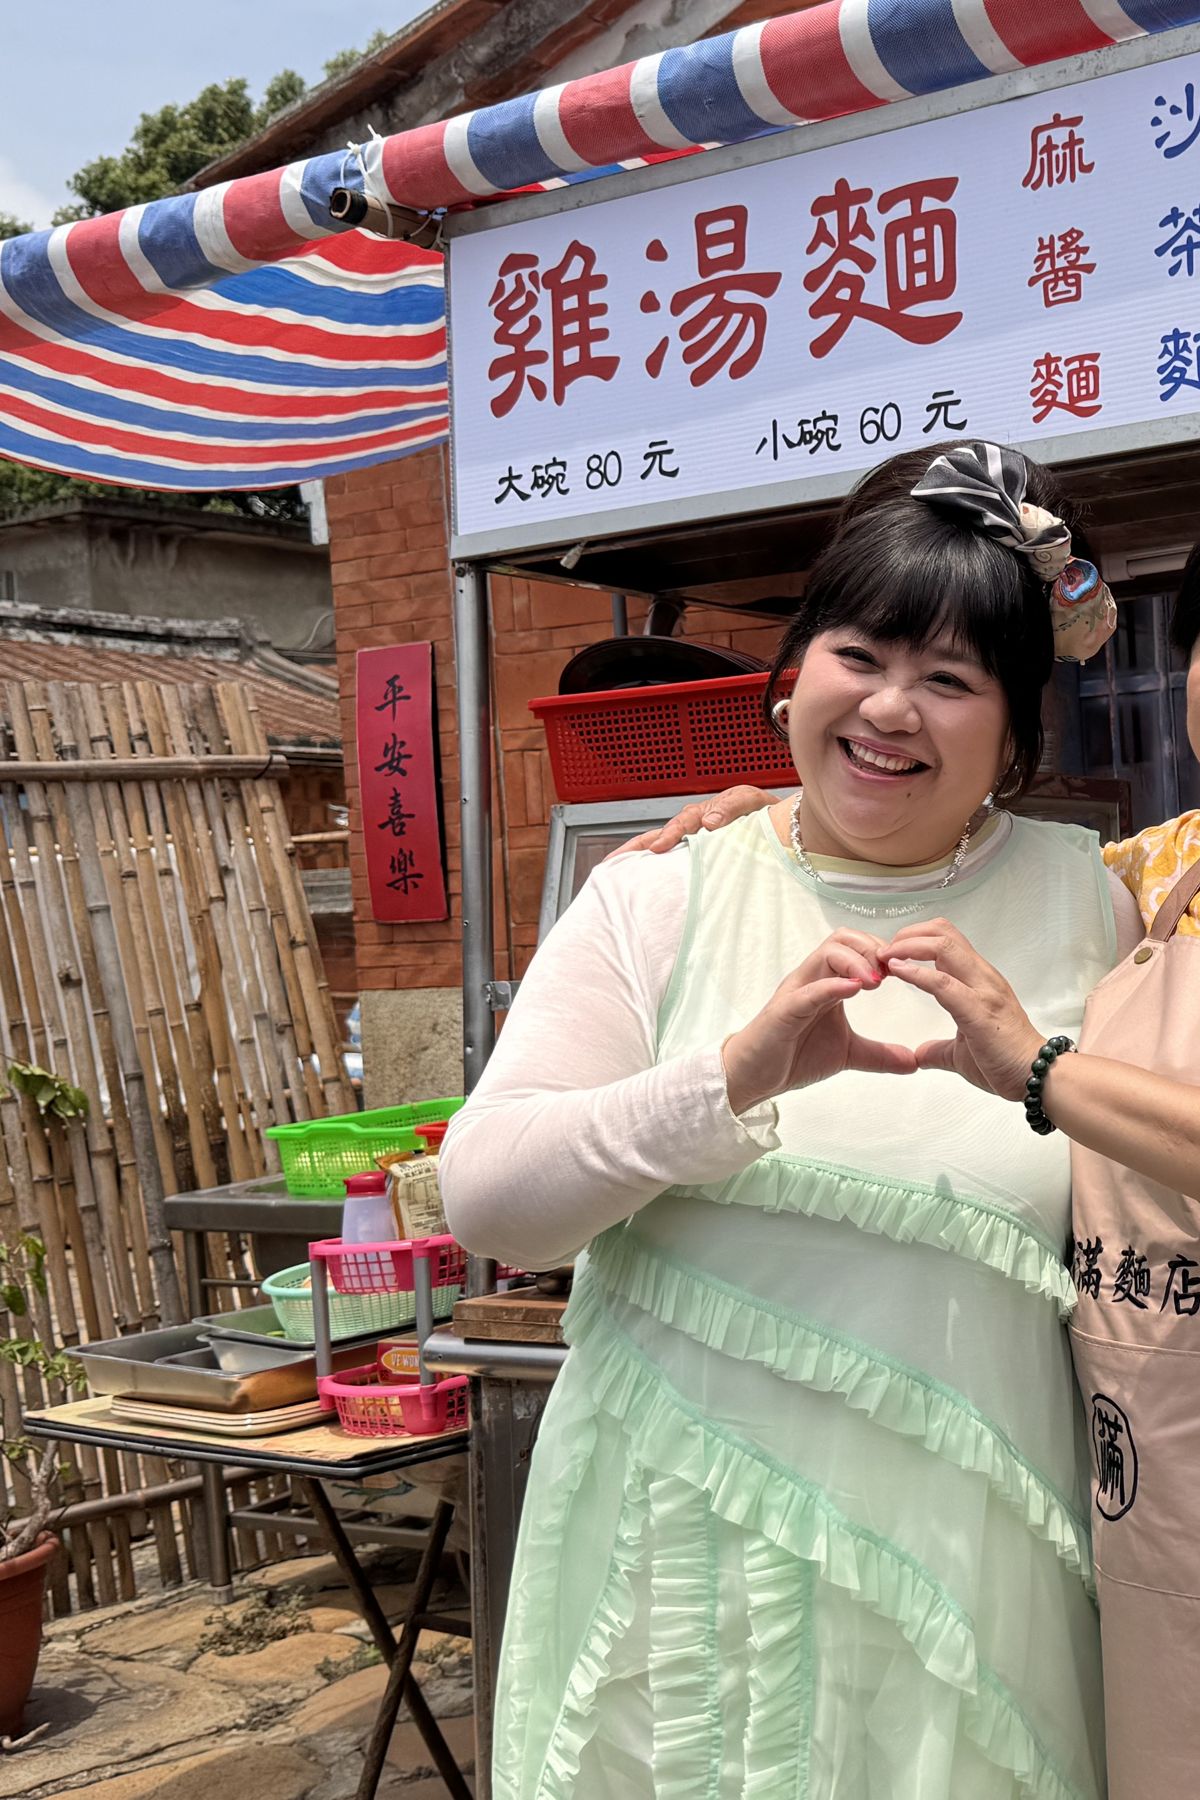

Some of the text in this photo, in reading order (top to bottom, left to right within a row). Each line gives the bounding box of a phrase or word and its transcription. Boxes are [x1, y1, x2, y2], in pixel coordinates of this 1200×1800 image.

[488, 176, 964, 418] 雞湯麵
[1021, 113, 1103, 424] 麻醬麵
[494, 440, 680, 504] 大碗 80 元
[755, 389, 968, 461] 小碗 60 元
[374, 674, 424, 895] 平安喜樂
